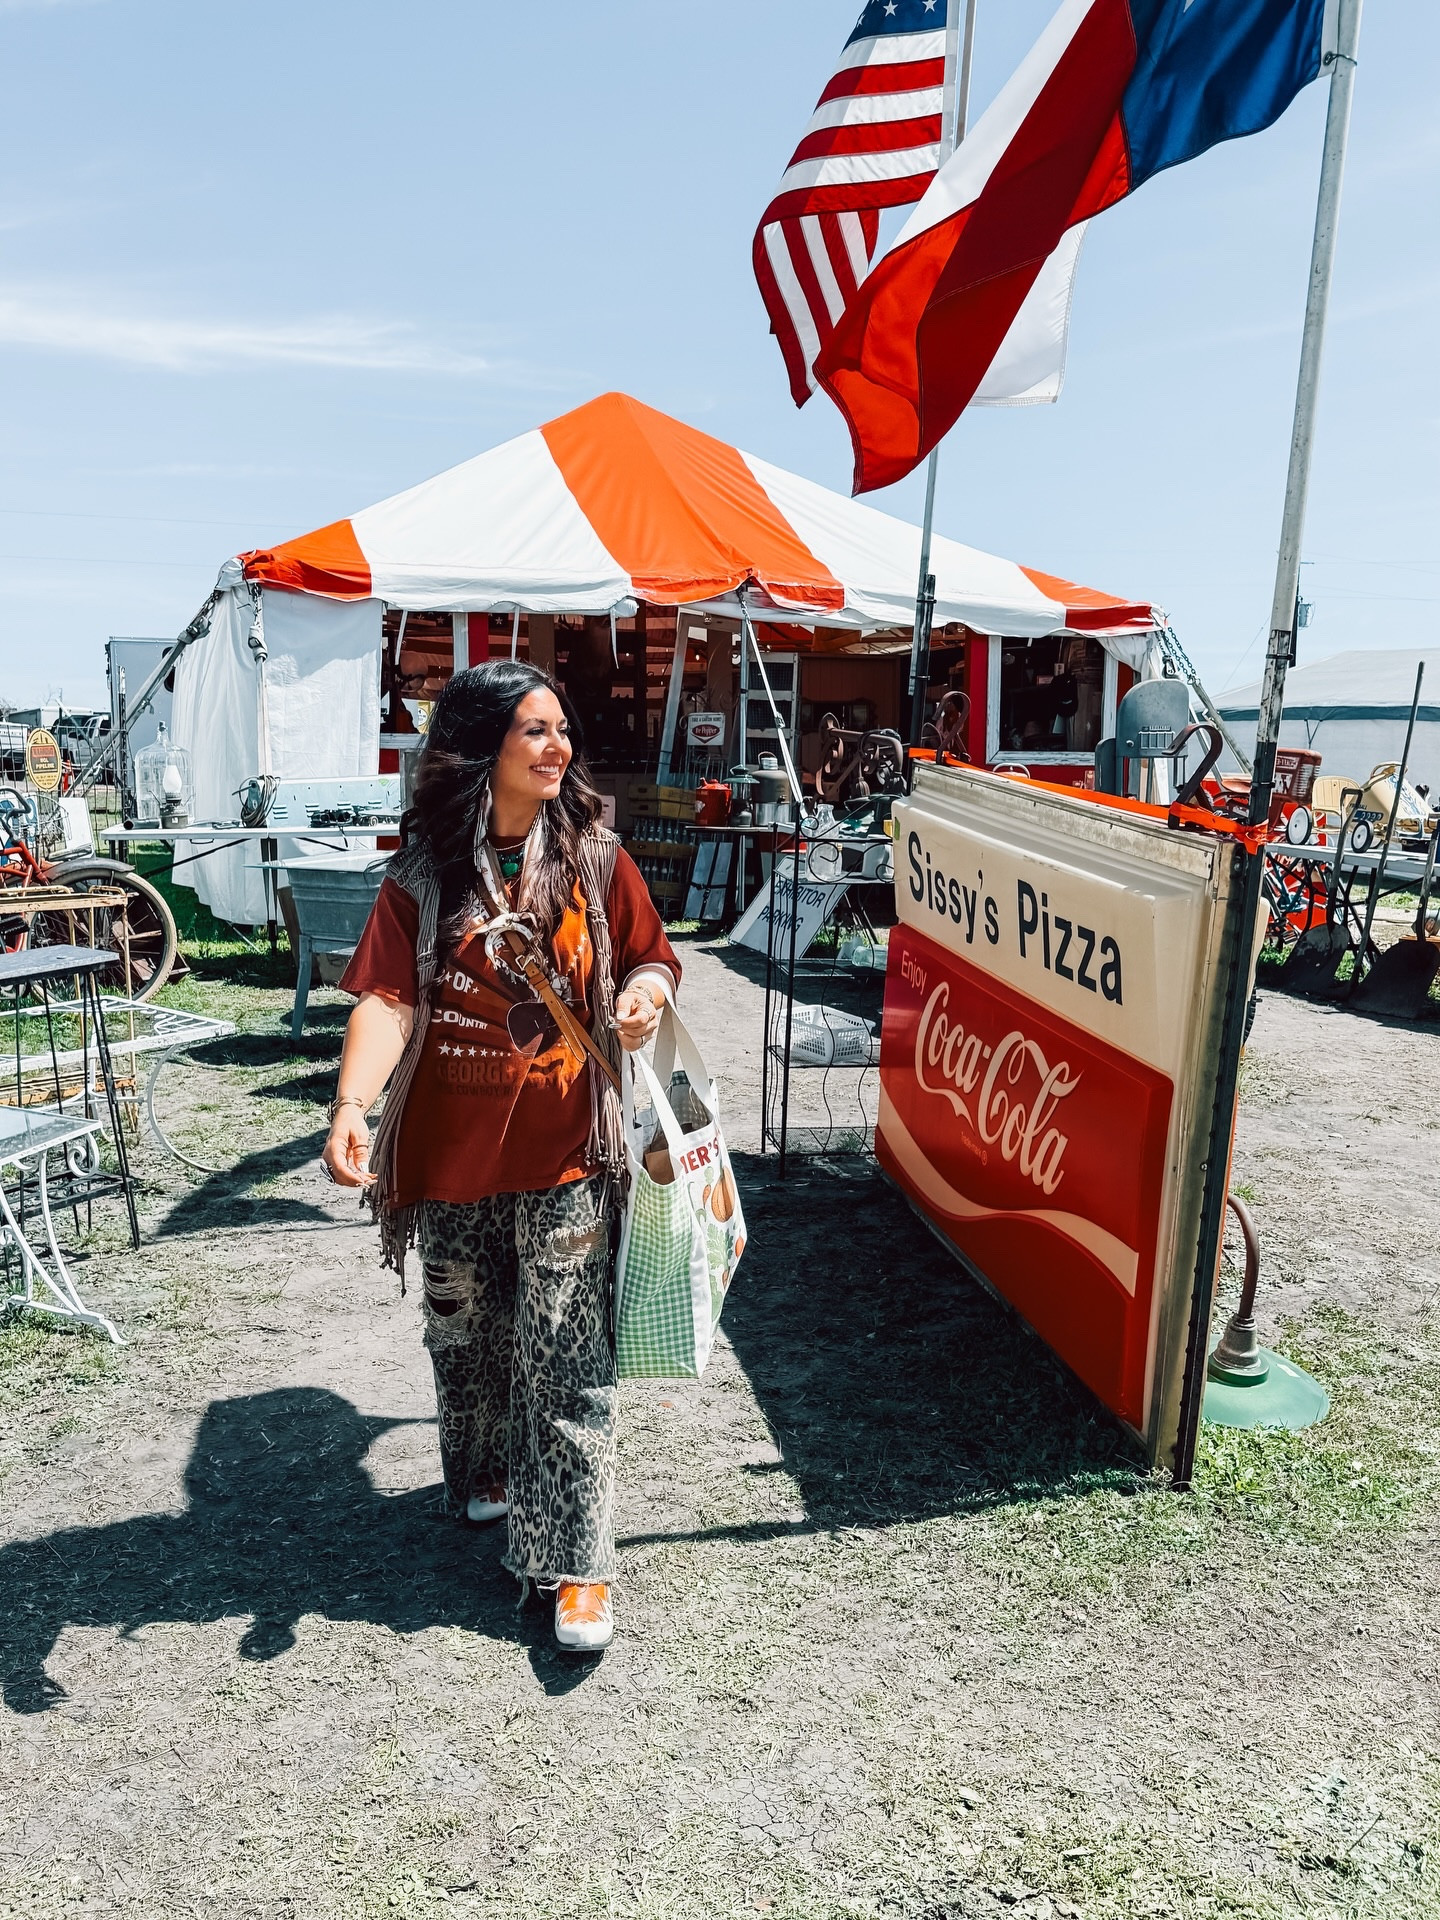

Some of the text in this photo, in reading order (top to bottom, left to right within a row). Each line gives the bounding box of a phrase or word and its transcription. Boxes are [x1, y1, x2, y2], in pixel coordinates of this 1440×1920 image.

[701, 726, 717, 736] Pepper
[774, 879, 826, 908] EXHBITOR
[908, 831, 1123, 1006] Sissy's Pizza
[452, 971, 473, 993] OF
[901, 951, 927, 995] Enjoy
[431, 1008, 488, 1030] COUNTRY
[915, 981, 1085, 1195] Coca-Cola
